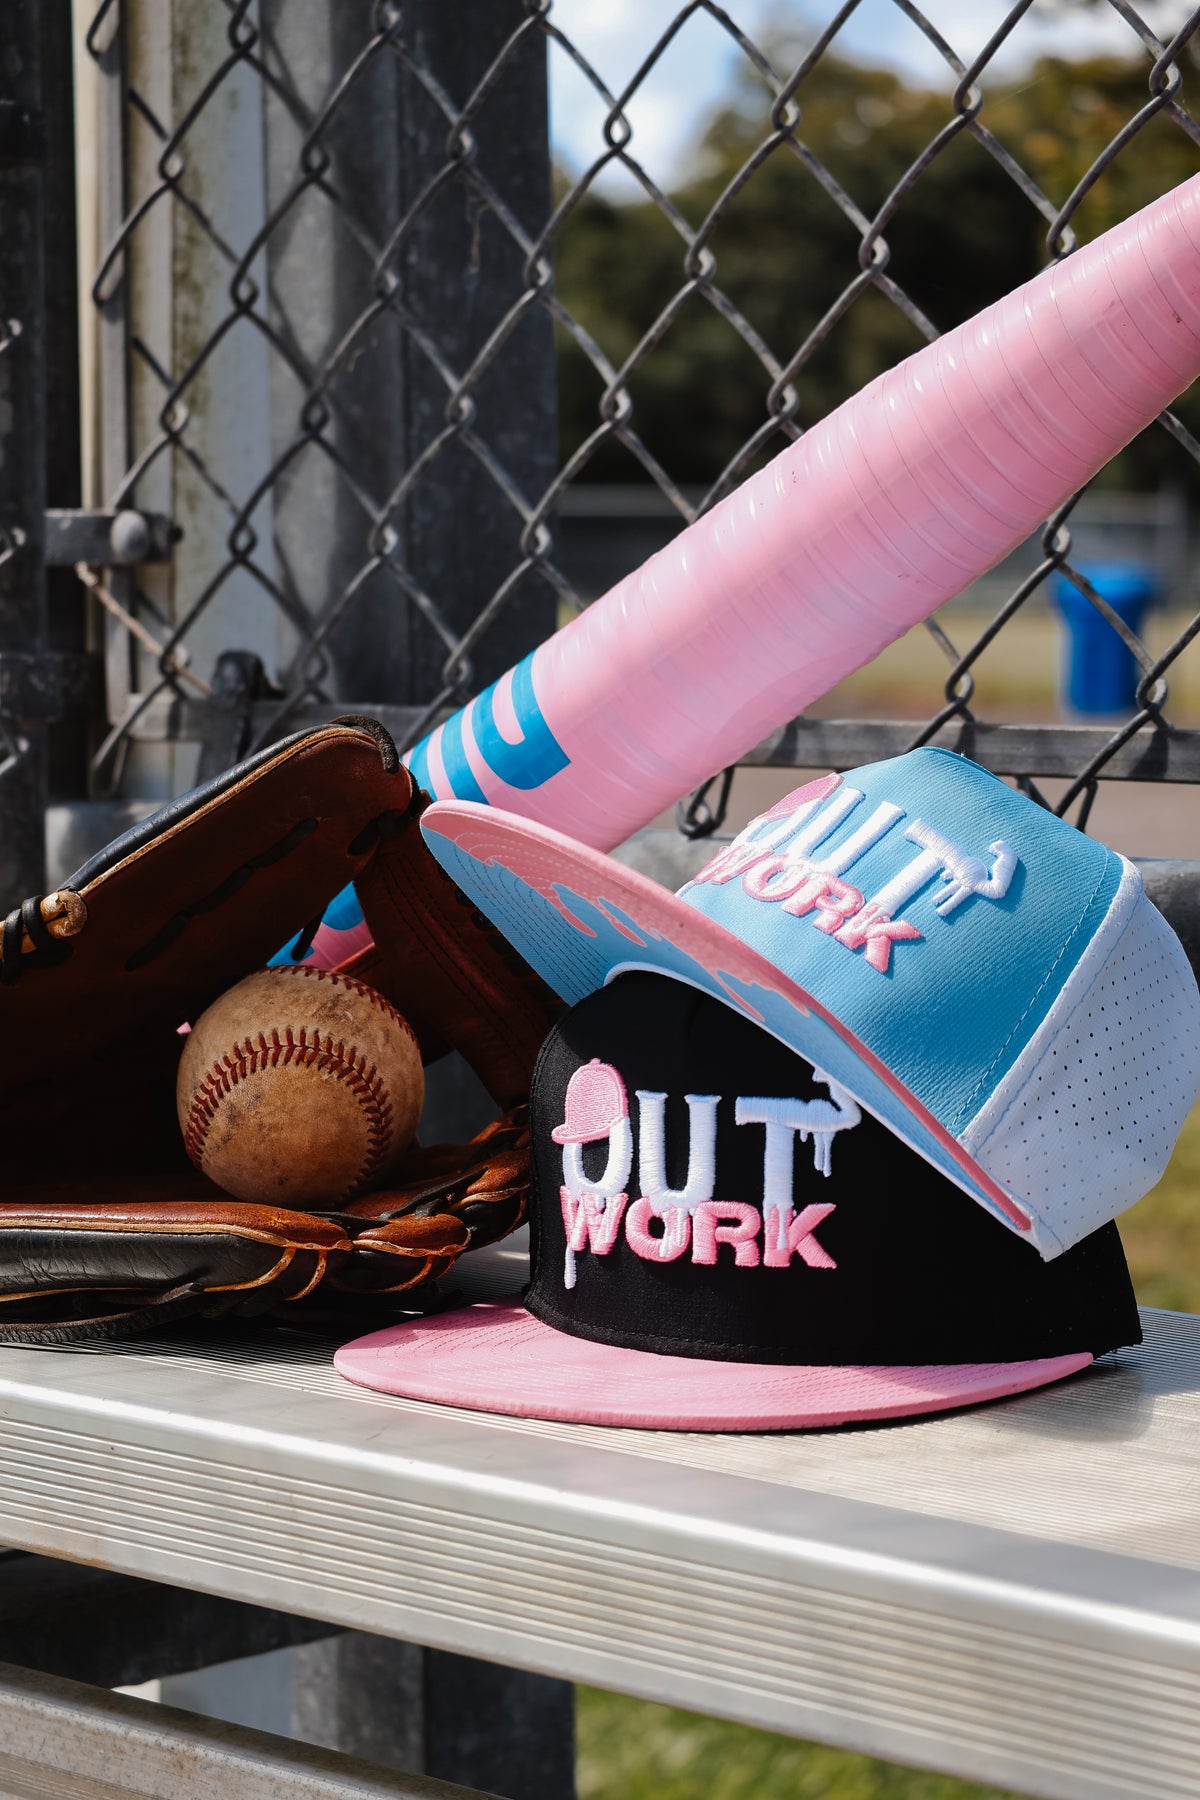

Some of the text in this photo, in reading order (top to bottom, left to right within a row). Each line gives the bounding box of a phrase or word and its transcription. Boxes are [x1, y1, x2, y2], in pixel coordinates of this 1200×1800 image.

[693, 846, 922, 974] WORK
[728, 775, 1018, 920] OUT
[553, 1060, 862, 1210] OUT
[559, 1185, 837, 1270] WORK
